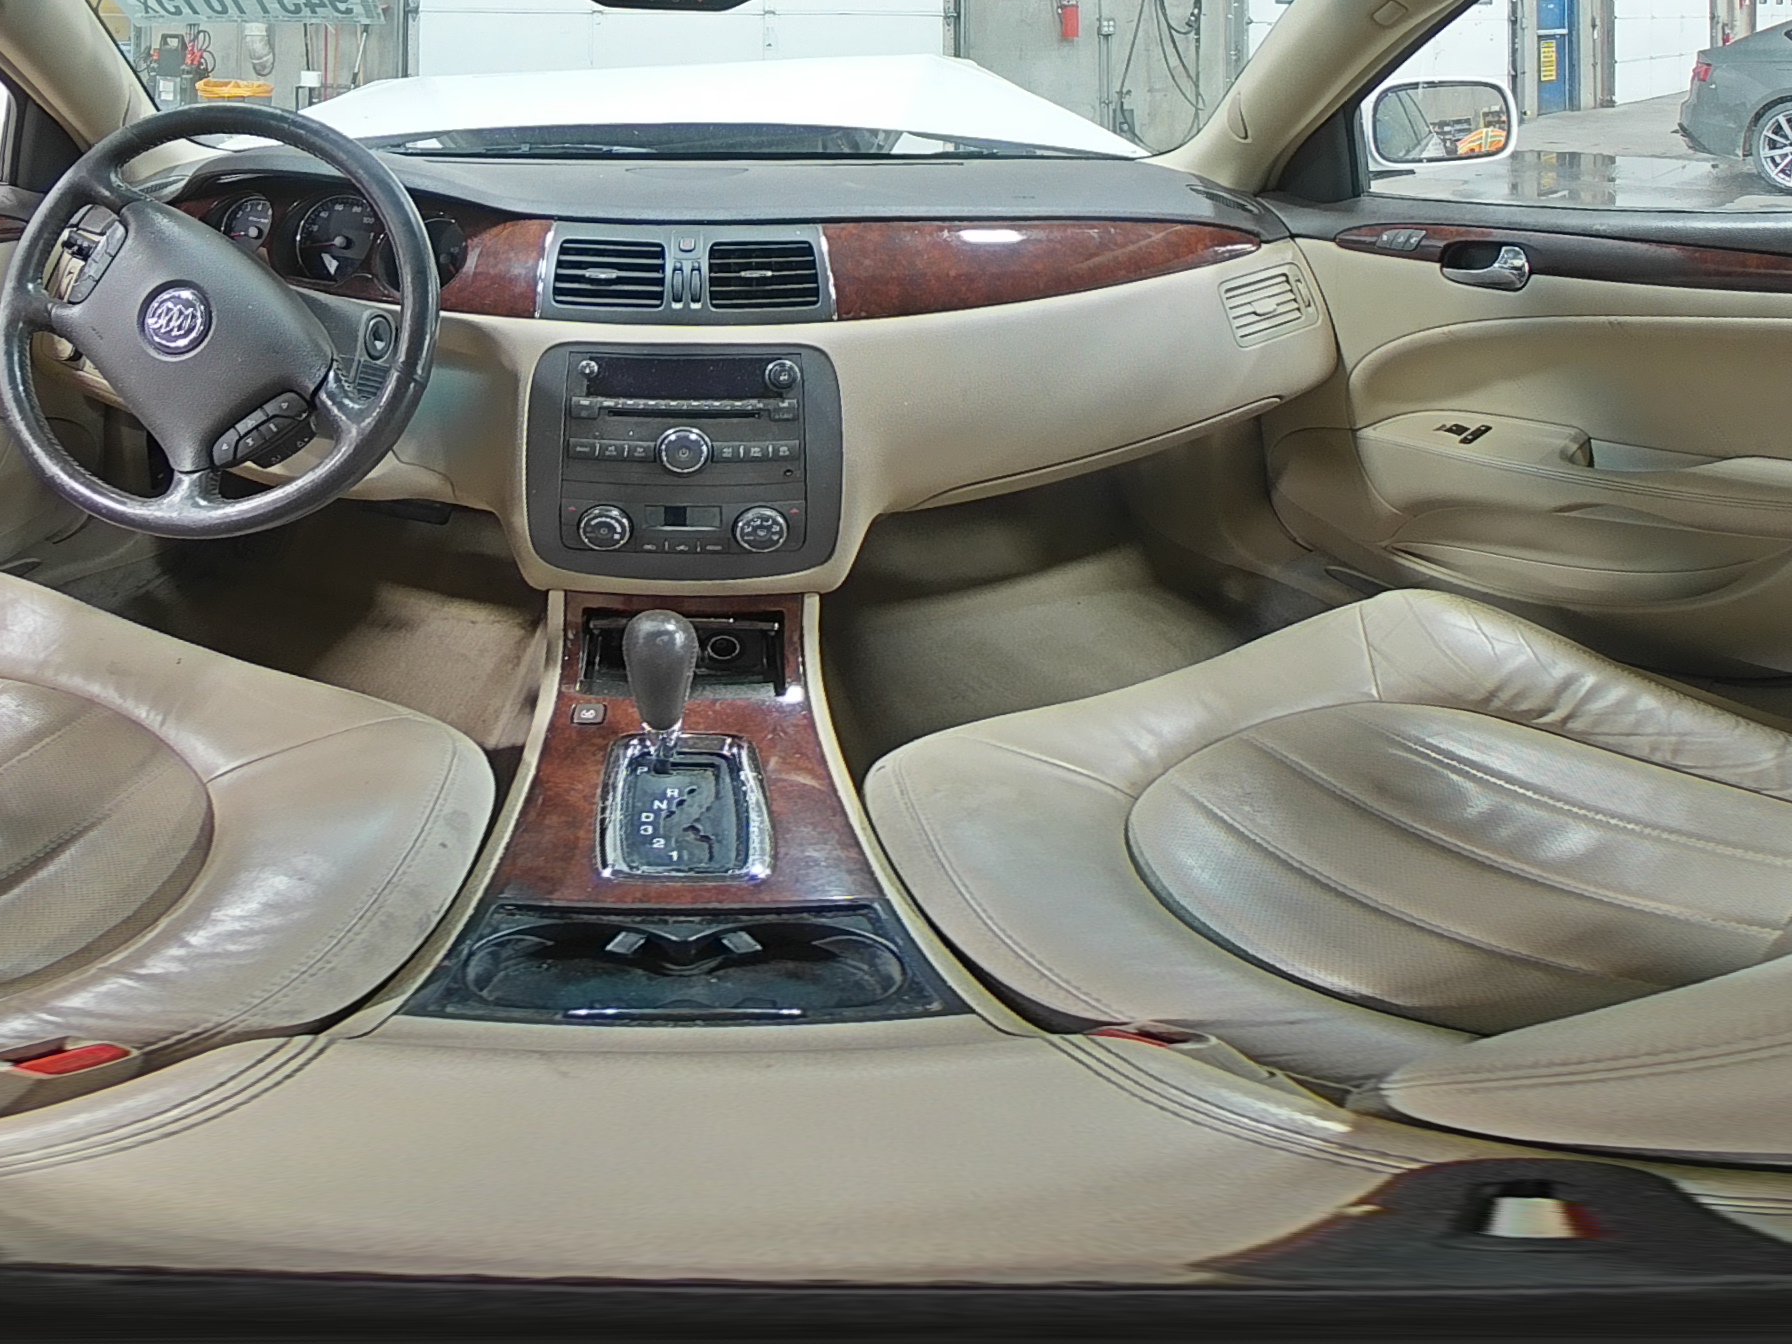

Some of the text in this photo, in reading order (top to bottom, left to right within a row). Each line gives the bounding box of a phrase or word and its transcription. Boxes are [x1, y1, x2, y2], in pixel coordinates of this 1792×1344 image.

[636, 766, 648, 775] P
[666, 788, 679, 798] R
[653, 799, 668, 810] N
[641, 812, 655, 822] D
[639, 825, 653, 835] 3
[652, 838, 666, 848] 2
[668, 850, 678, 862] 1
